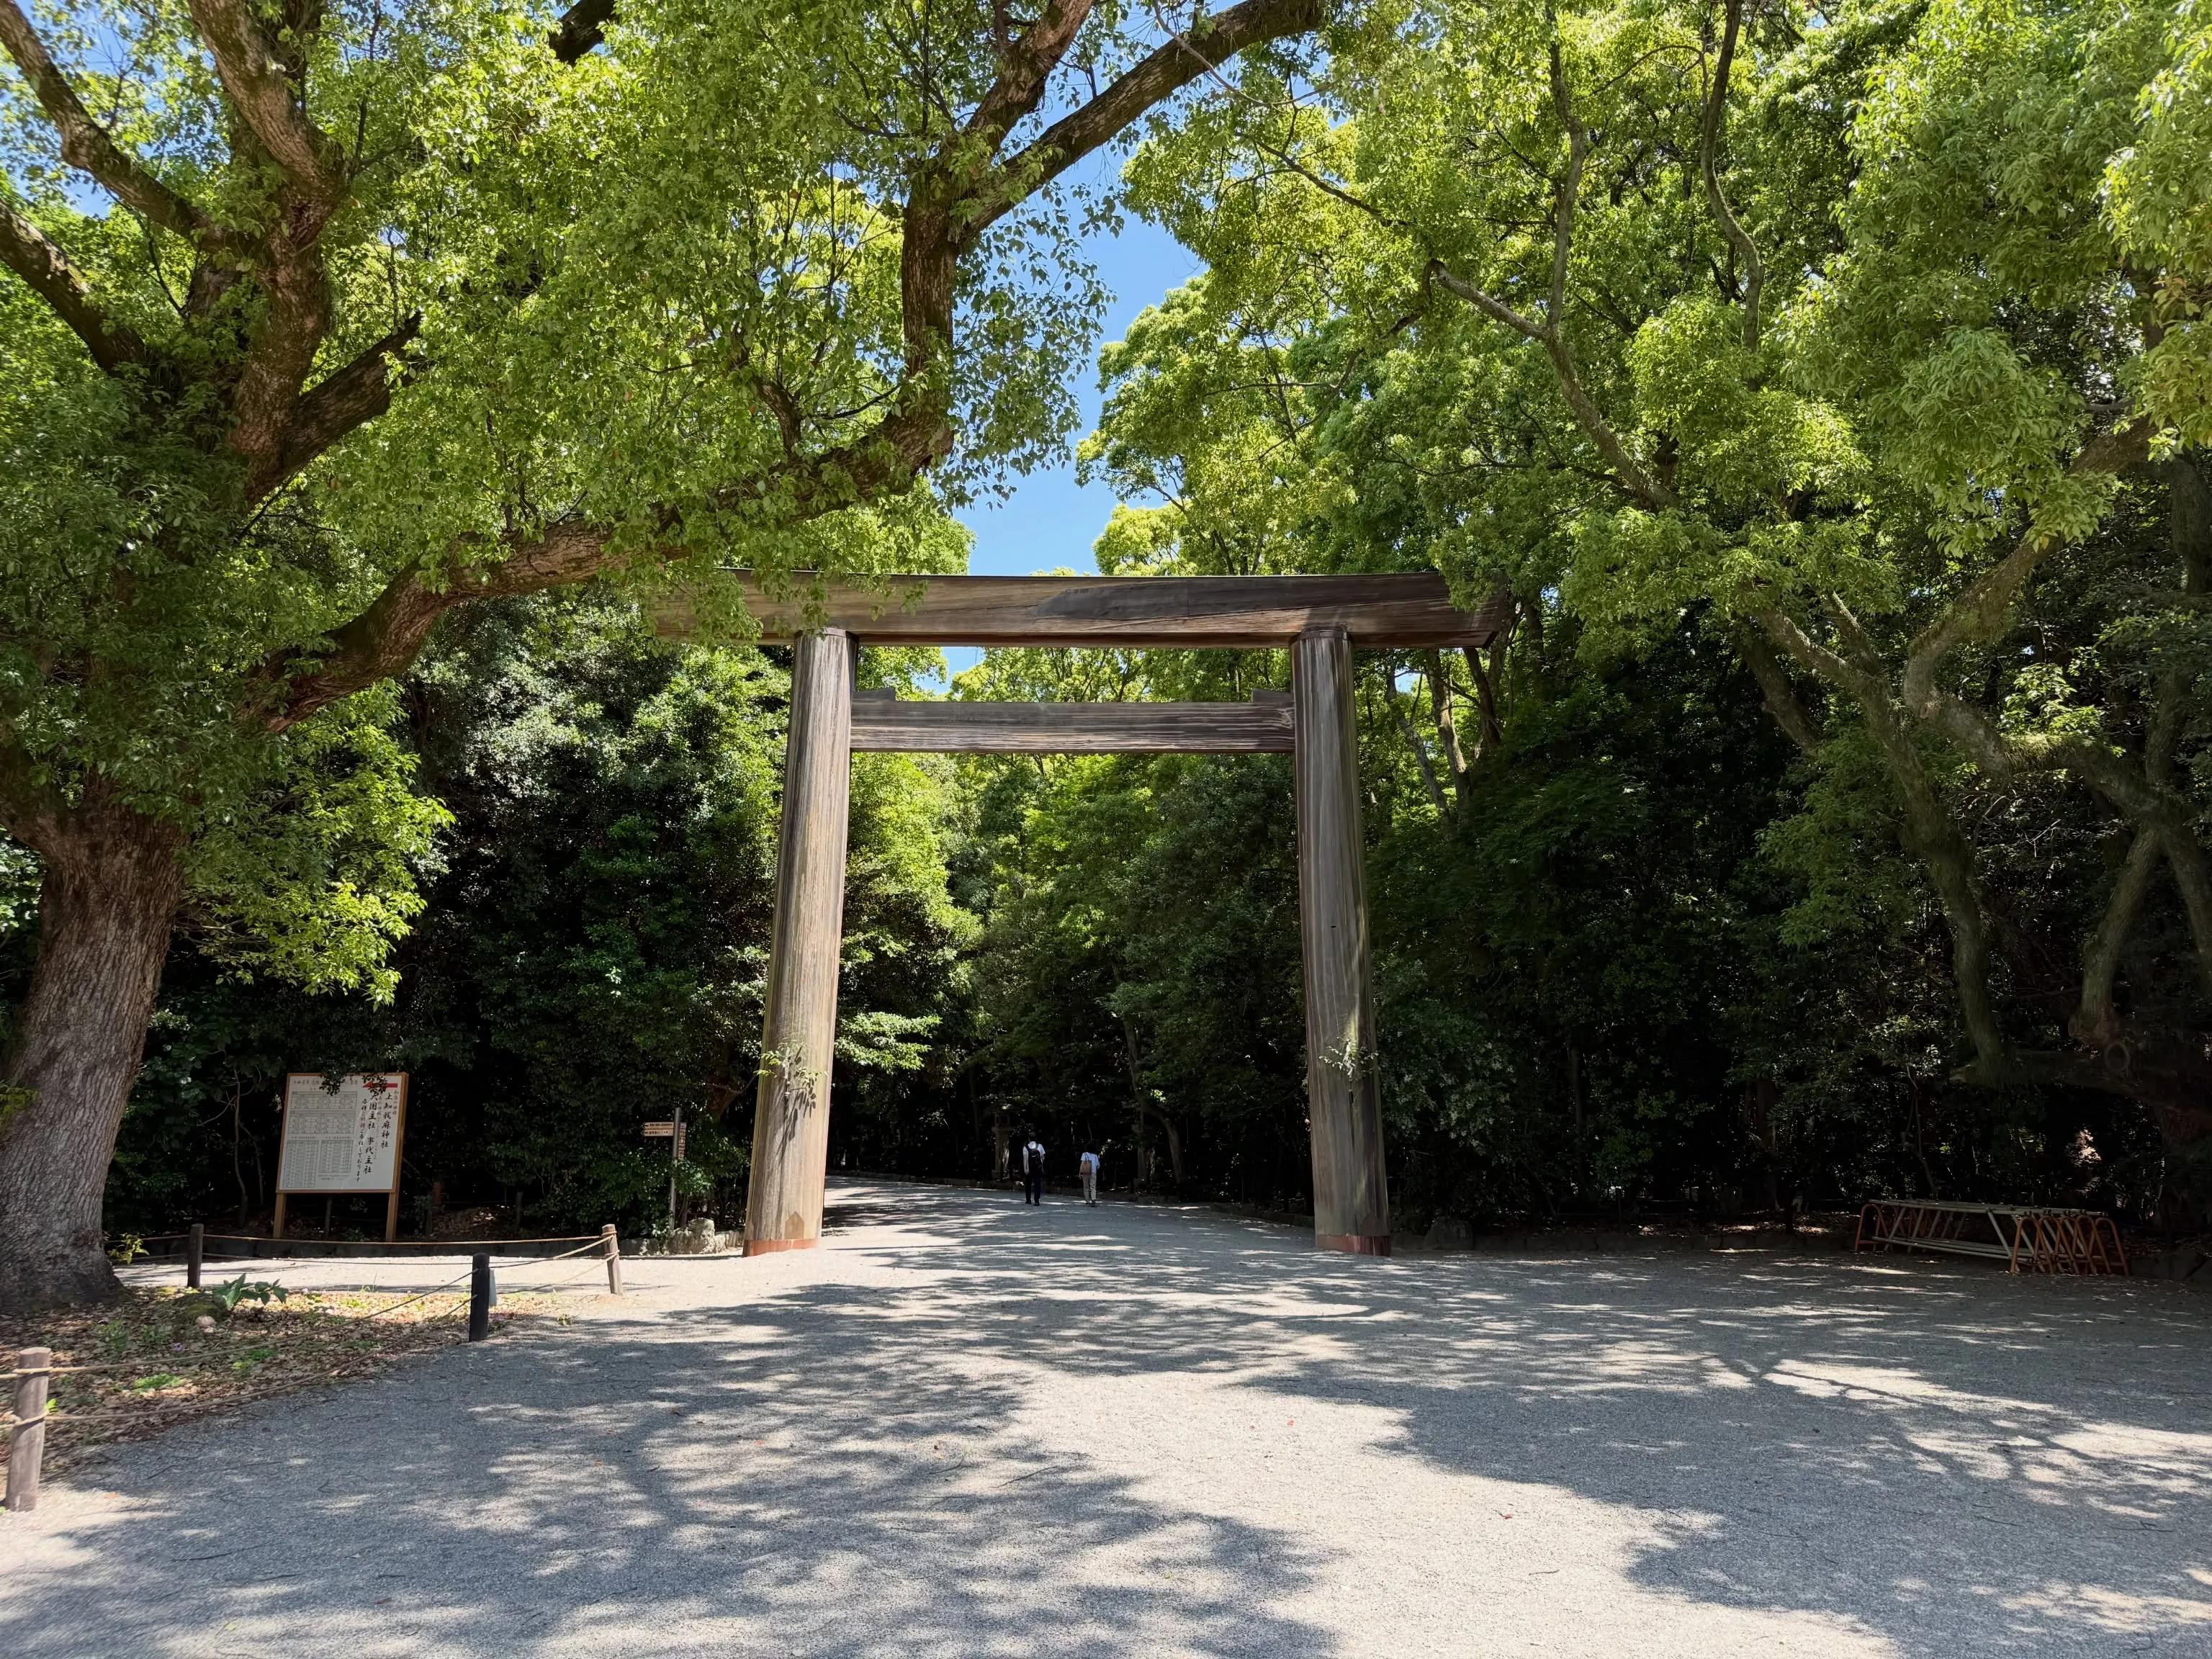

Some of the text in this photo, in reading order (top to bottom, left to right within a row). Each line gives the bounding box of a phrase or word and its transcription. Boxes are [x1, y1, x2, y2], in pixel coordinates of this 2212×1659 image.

[380, 1092, 392, 1148] 上知我麻神社
[363, 1137, 374, 1174] 事代主社
